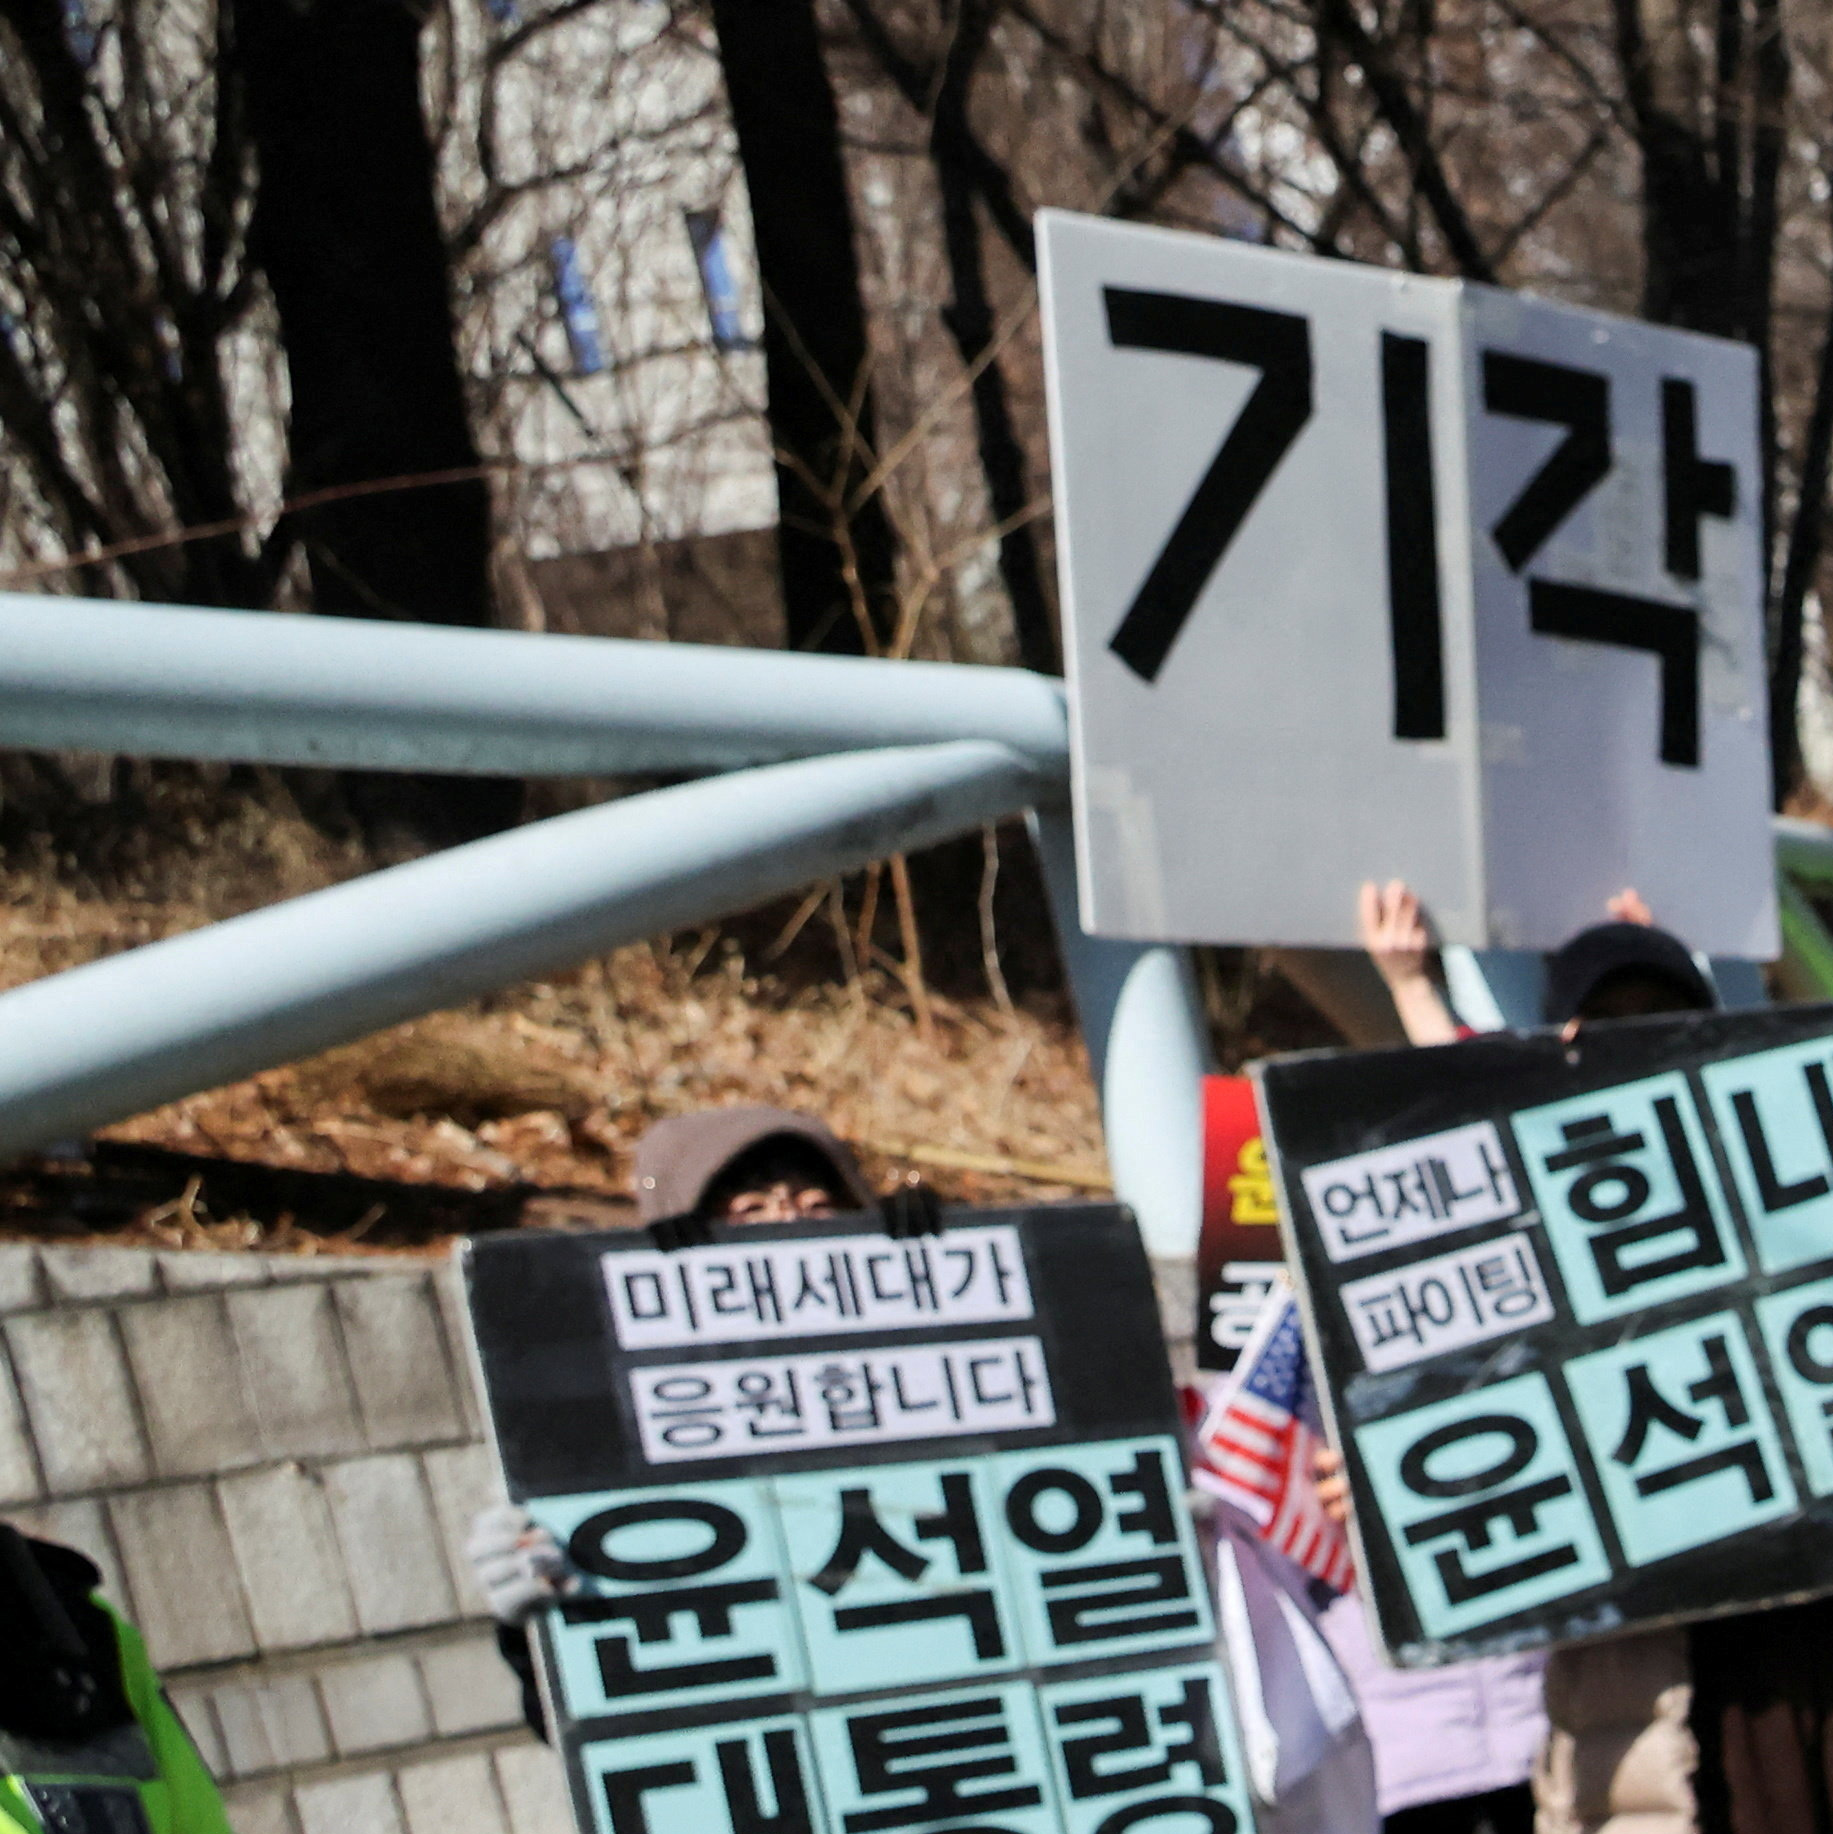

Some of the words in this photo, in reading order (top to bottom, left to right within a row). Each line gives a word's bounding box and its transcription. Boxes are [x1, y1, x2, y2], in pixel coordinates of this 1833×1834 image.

[1102, 284, 1737, 769] 기각
[1322, 1139, 1517, 1245] 언제나
[621, 1238, 1022, 1331] 미래세대가
[1364, 1245, 1543, 1352] 파이팅
[644, 1346, 1042, 1452] 응원합니다
[563, 1450, 1199, 1700] 윤석열
